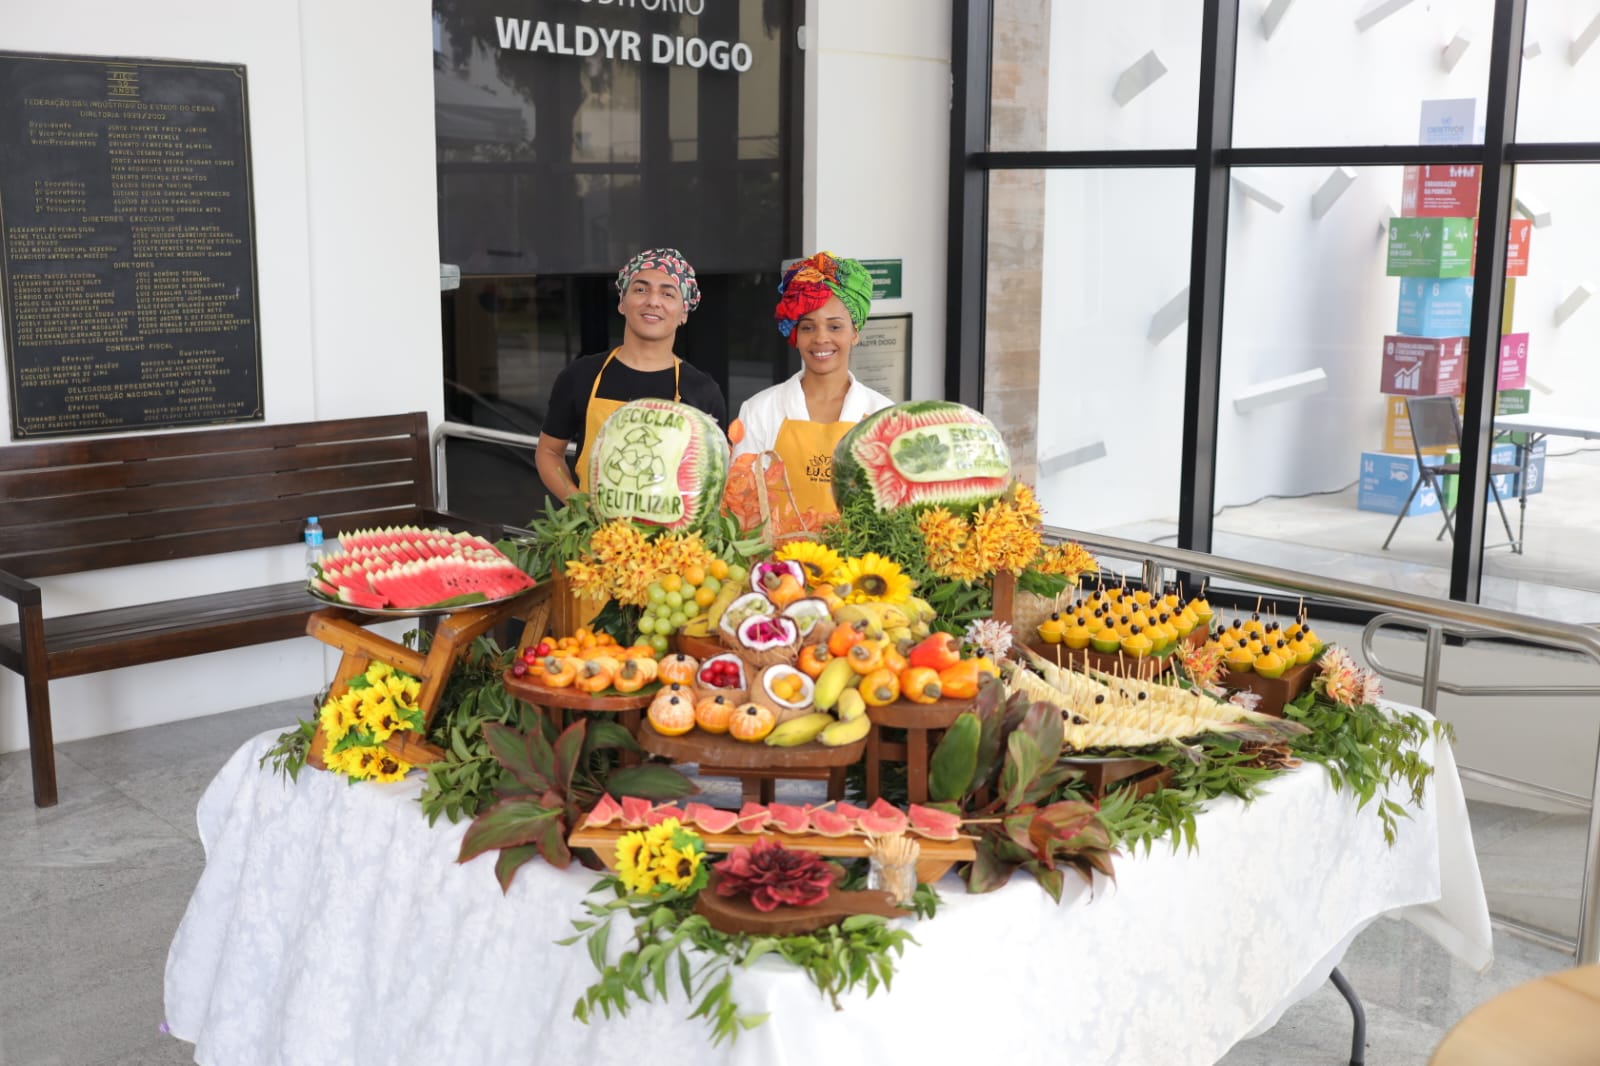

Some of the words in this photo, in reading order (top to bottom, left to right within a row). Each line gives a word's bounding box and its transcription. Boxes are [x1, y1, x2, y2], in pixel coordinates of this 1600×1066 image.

[495, 16, 642, 62] WALDYR
[652, 33, 753, 72] DIOGO
[80, 111, 120, 119] DIRETORIA
[68, 385, 112, 394] DELEGADOS
[114, 381, 179, 390] REPRESENTANTES
[64, 392, 123, 402] CONFEDERAÇÃO
[126, 390, 163, 398] NACIONAL
[597, 484, 681, 515] REUTILIZAR
